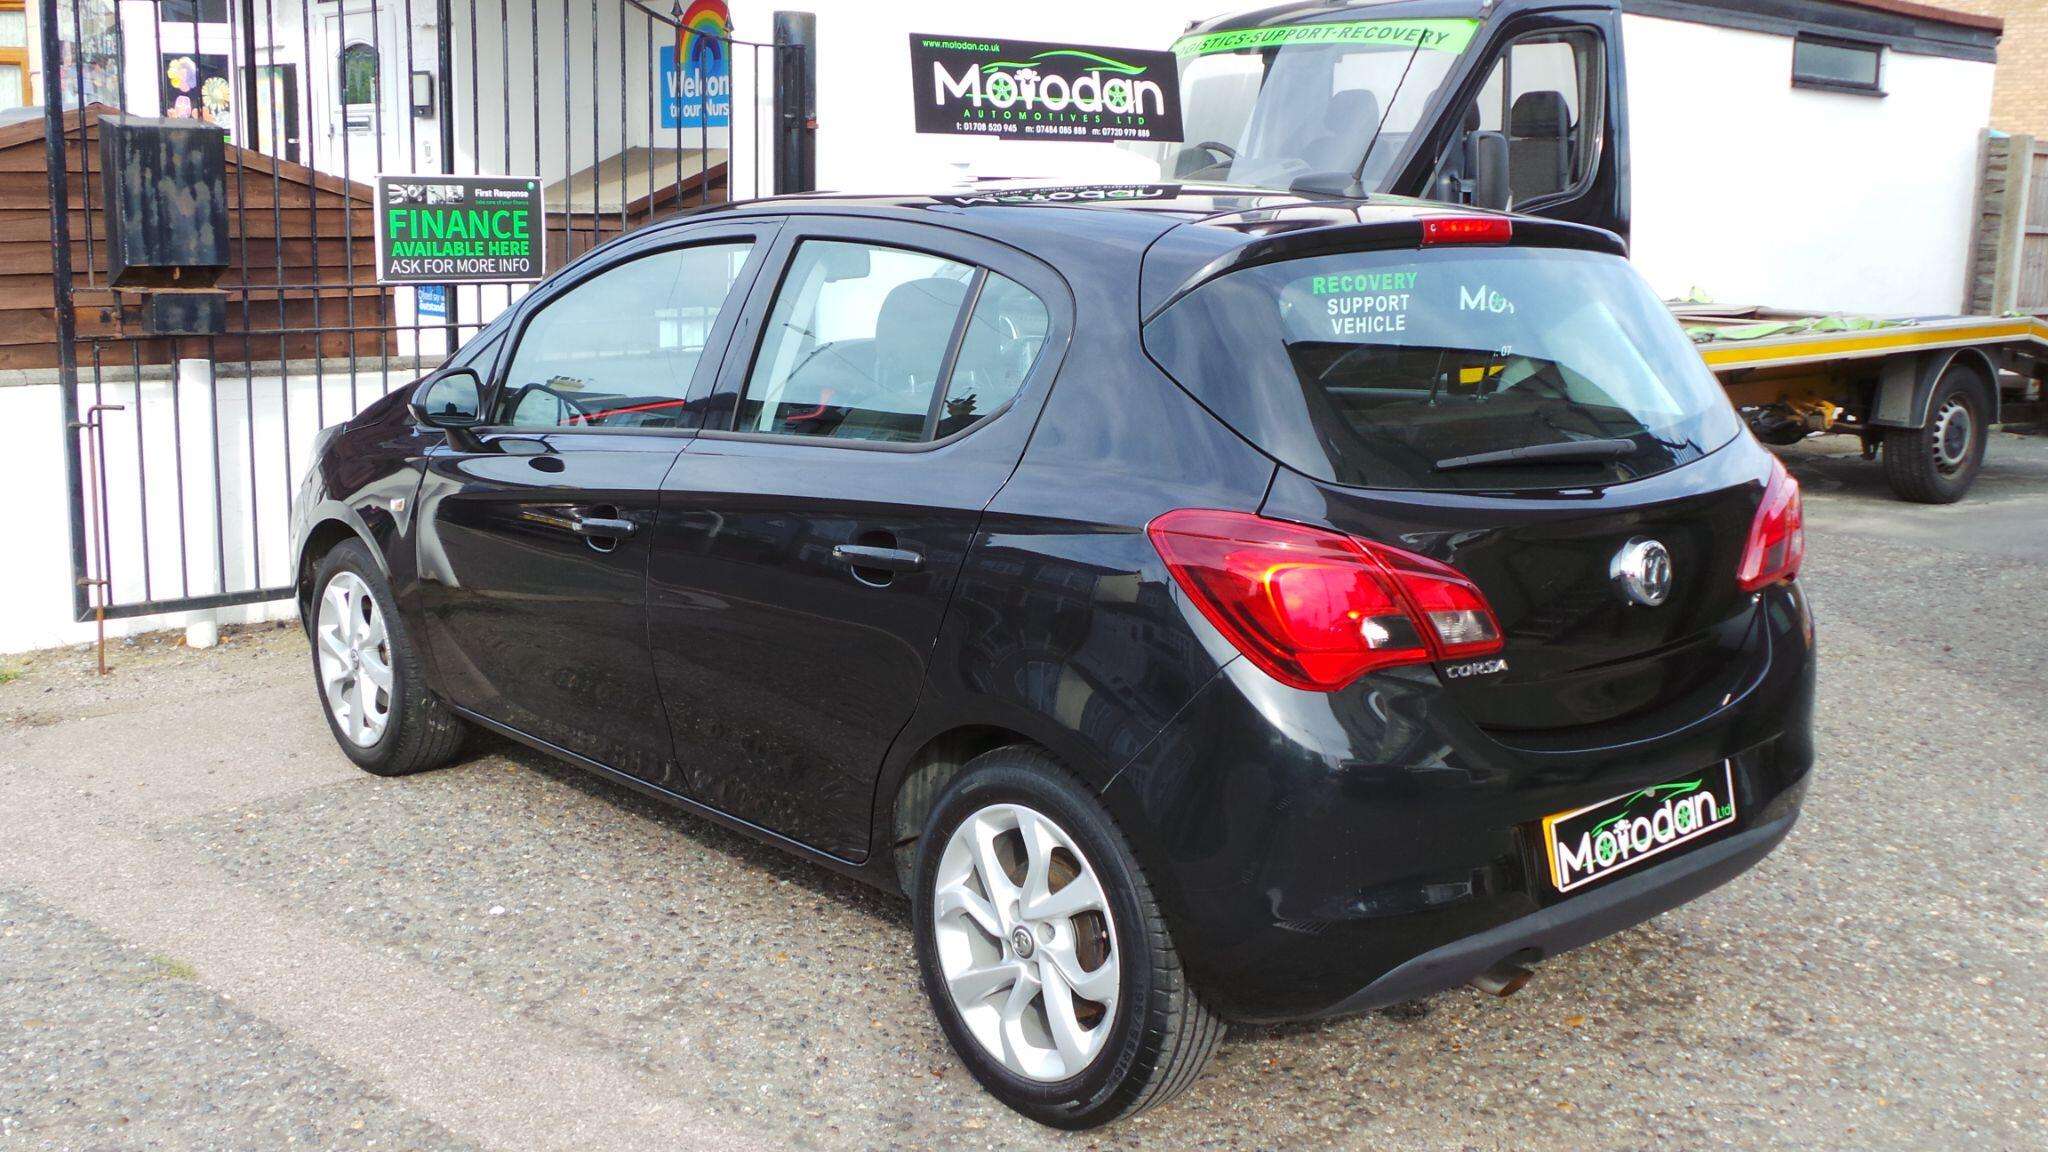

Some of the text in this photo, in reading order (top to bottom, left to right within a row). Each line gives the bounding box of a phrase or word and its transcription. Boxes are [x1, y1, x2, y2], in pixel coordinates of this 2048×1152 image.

[922, 39, 1000, 52] www.motodan.co.uk
[683, 103, 702, 117] our
[963, 110, 1146, 126] AUTOMOTIVES LTD
[963, 122, 987, 131] 01708
[988, 123, 1002, 132] 520
[1101, 127, 1124, 137] 07720
[1124, 128, 1137, 137] 979
[474, 189, 529, 199] First Response
[389, 210, 530, 239] FINANCE
[391, 241, 530, 257] AVAILABLE HERE
[390, 258, 531, 275] ASK FOR MORE INFO
[1311, 272, 1418, 295] RECOVERY
[1327, 294, 1410, 316] SUPPORT
[1331, 314, 1406, 335] VEHICLE
[1445, 658, 1509, 679] CORSA
[1558, 790, 1732, 884] Motodan Ltd
